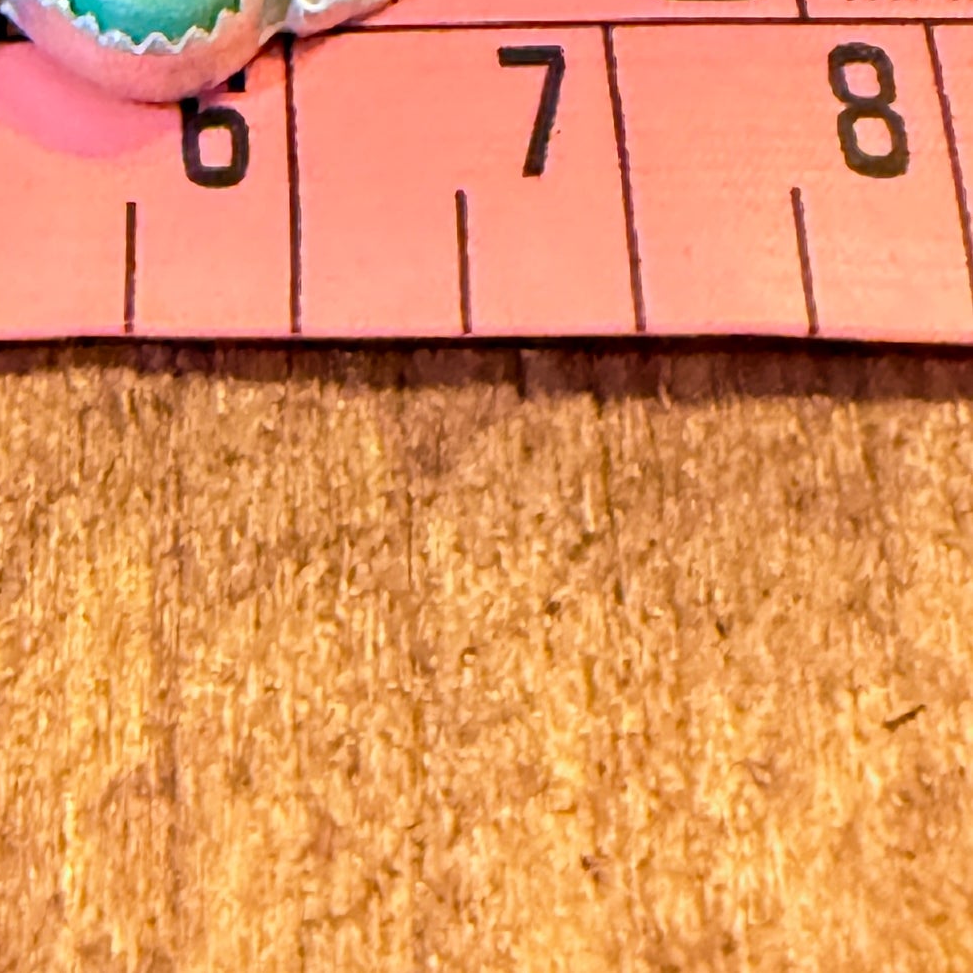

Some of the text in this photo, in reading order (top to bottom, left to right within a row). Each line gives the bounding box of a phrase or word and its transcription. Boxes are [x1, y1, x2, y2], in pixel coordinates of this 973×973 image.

[180, 67, 249, 189] 6
[497, 44, 566, 178] 7
[827, 41, 910, 179] 8
